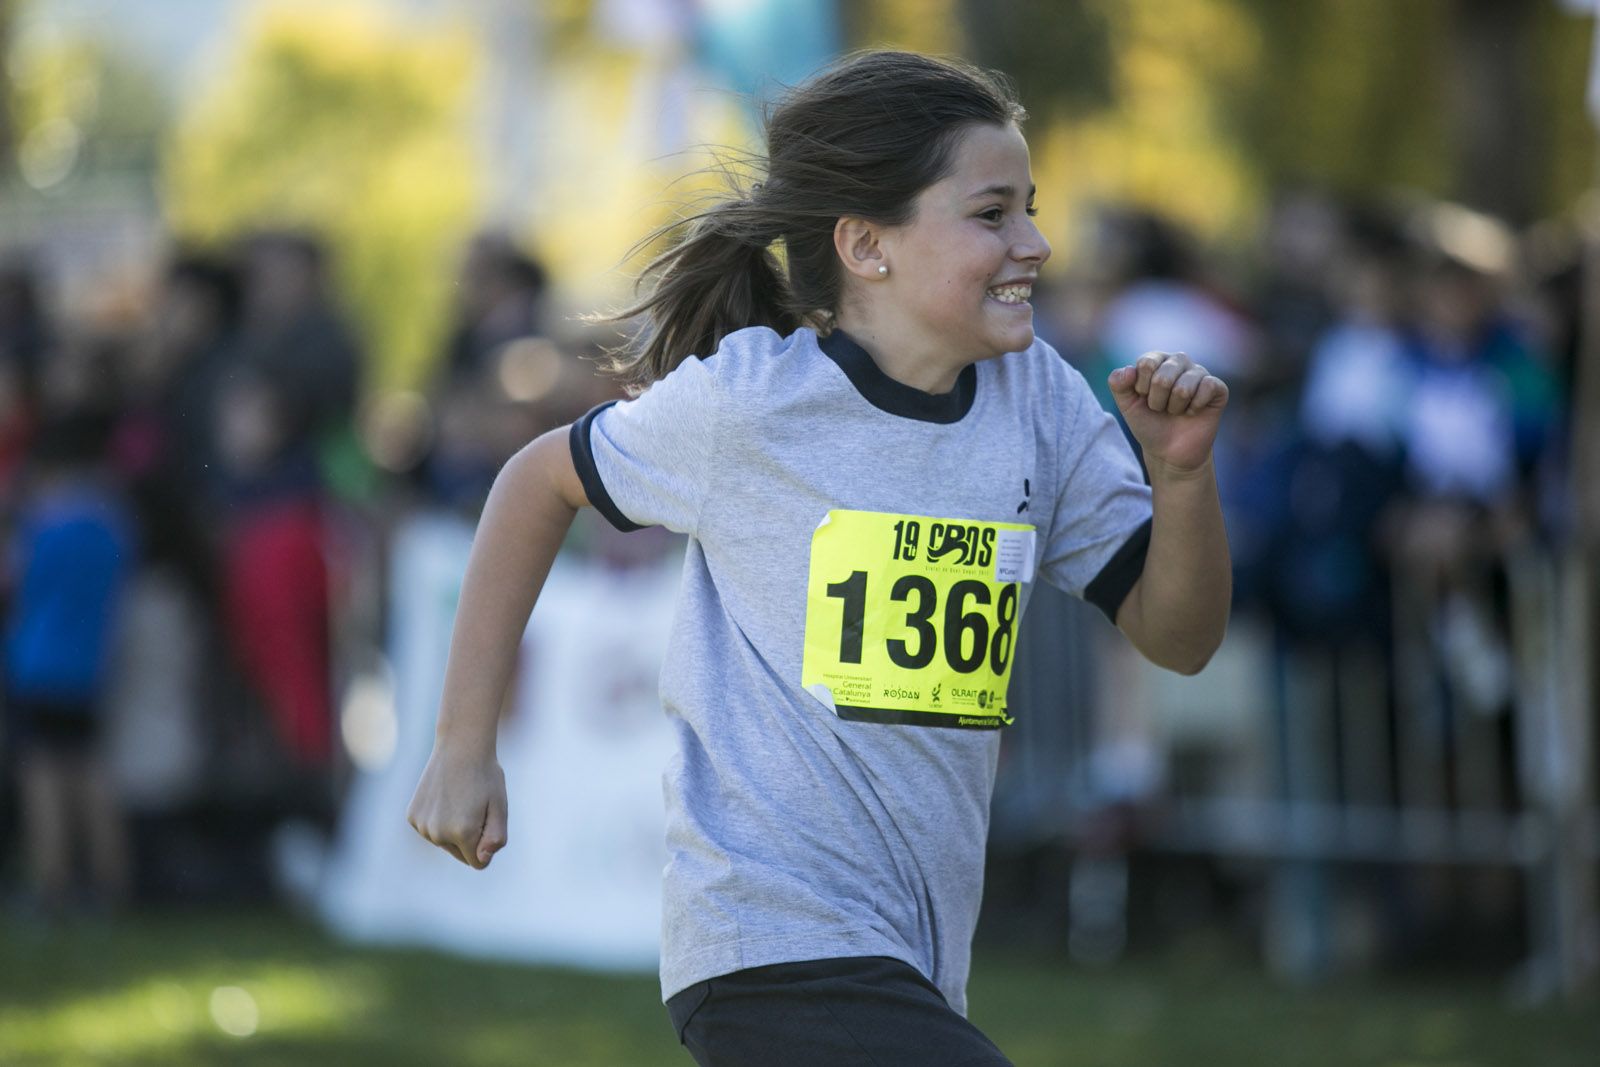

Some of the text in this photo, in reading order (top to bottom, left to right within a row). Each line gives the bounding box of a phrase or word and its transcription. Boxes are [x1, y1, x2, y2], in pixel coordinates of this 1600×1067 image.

[893, 520, 920, 561] 19
[826, 570, 1017, 677] 1368
[842, 680, 872, 690] General
[833, 687, 871, 698] Catalunya
[951, 688, 978, 698] OLRAIT
